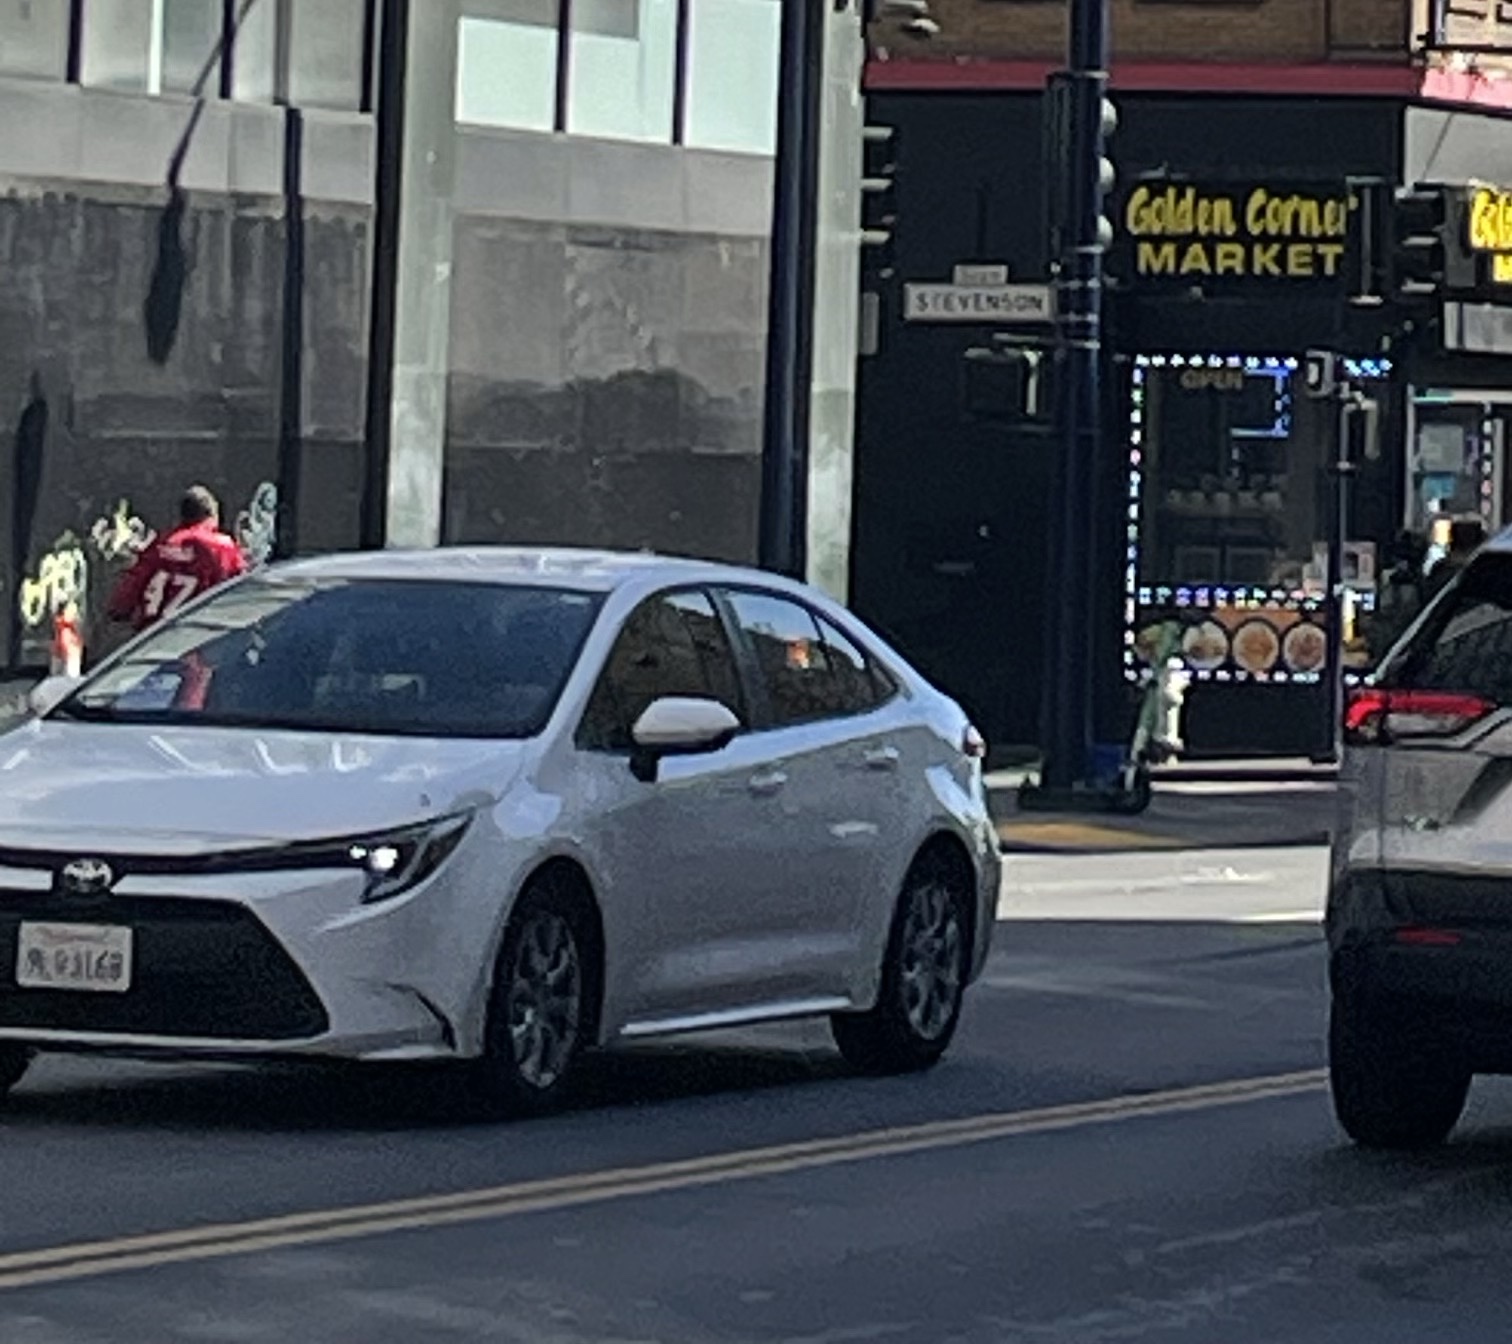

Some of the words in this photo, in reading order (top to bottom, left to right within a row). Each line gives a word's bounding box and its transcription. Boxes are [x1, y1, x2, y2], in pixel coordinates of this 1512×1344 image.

[1126, 186, 1236, 236] Golden
[1137, 242, 1344, 276] MARKET
[915, 291, 1043, 312] STEVENSON
